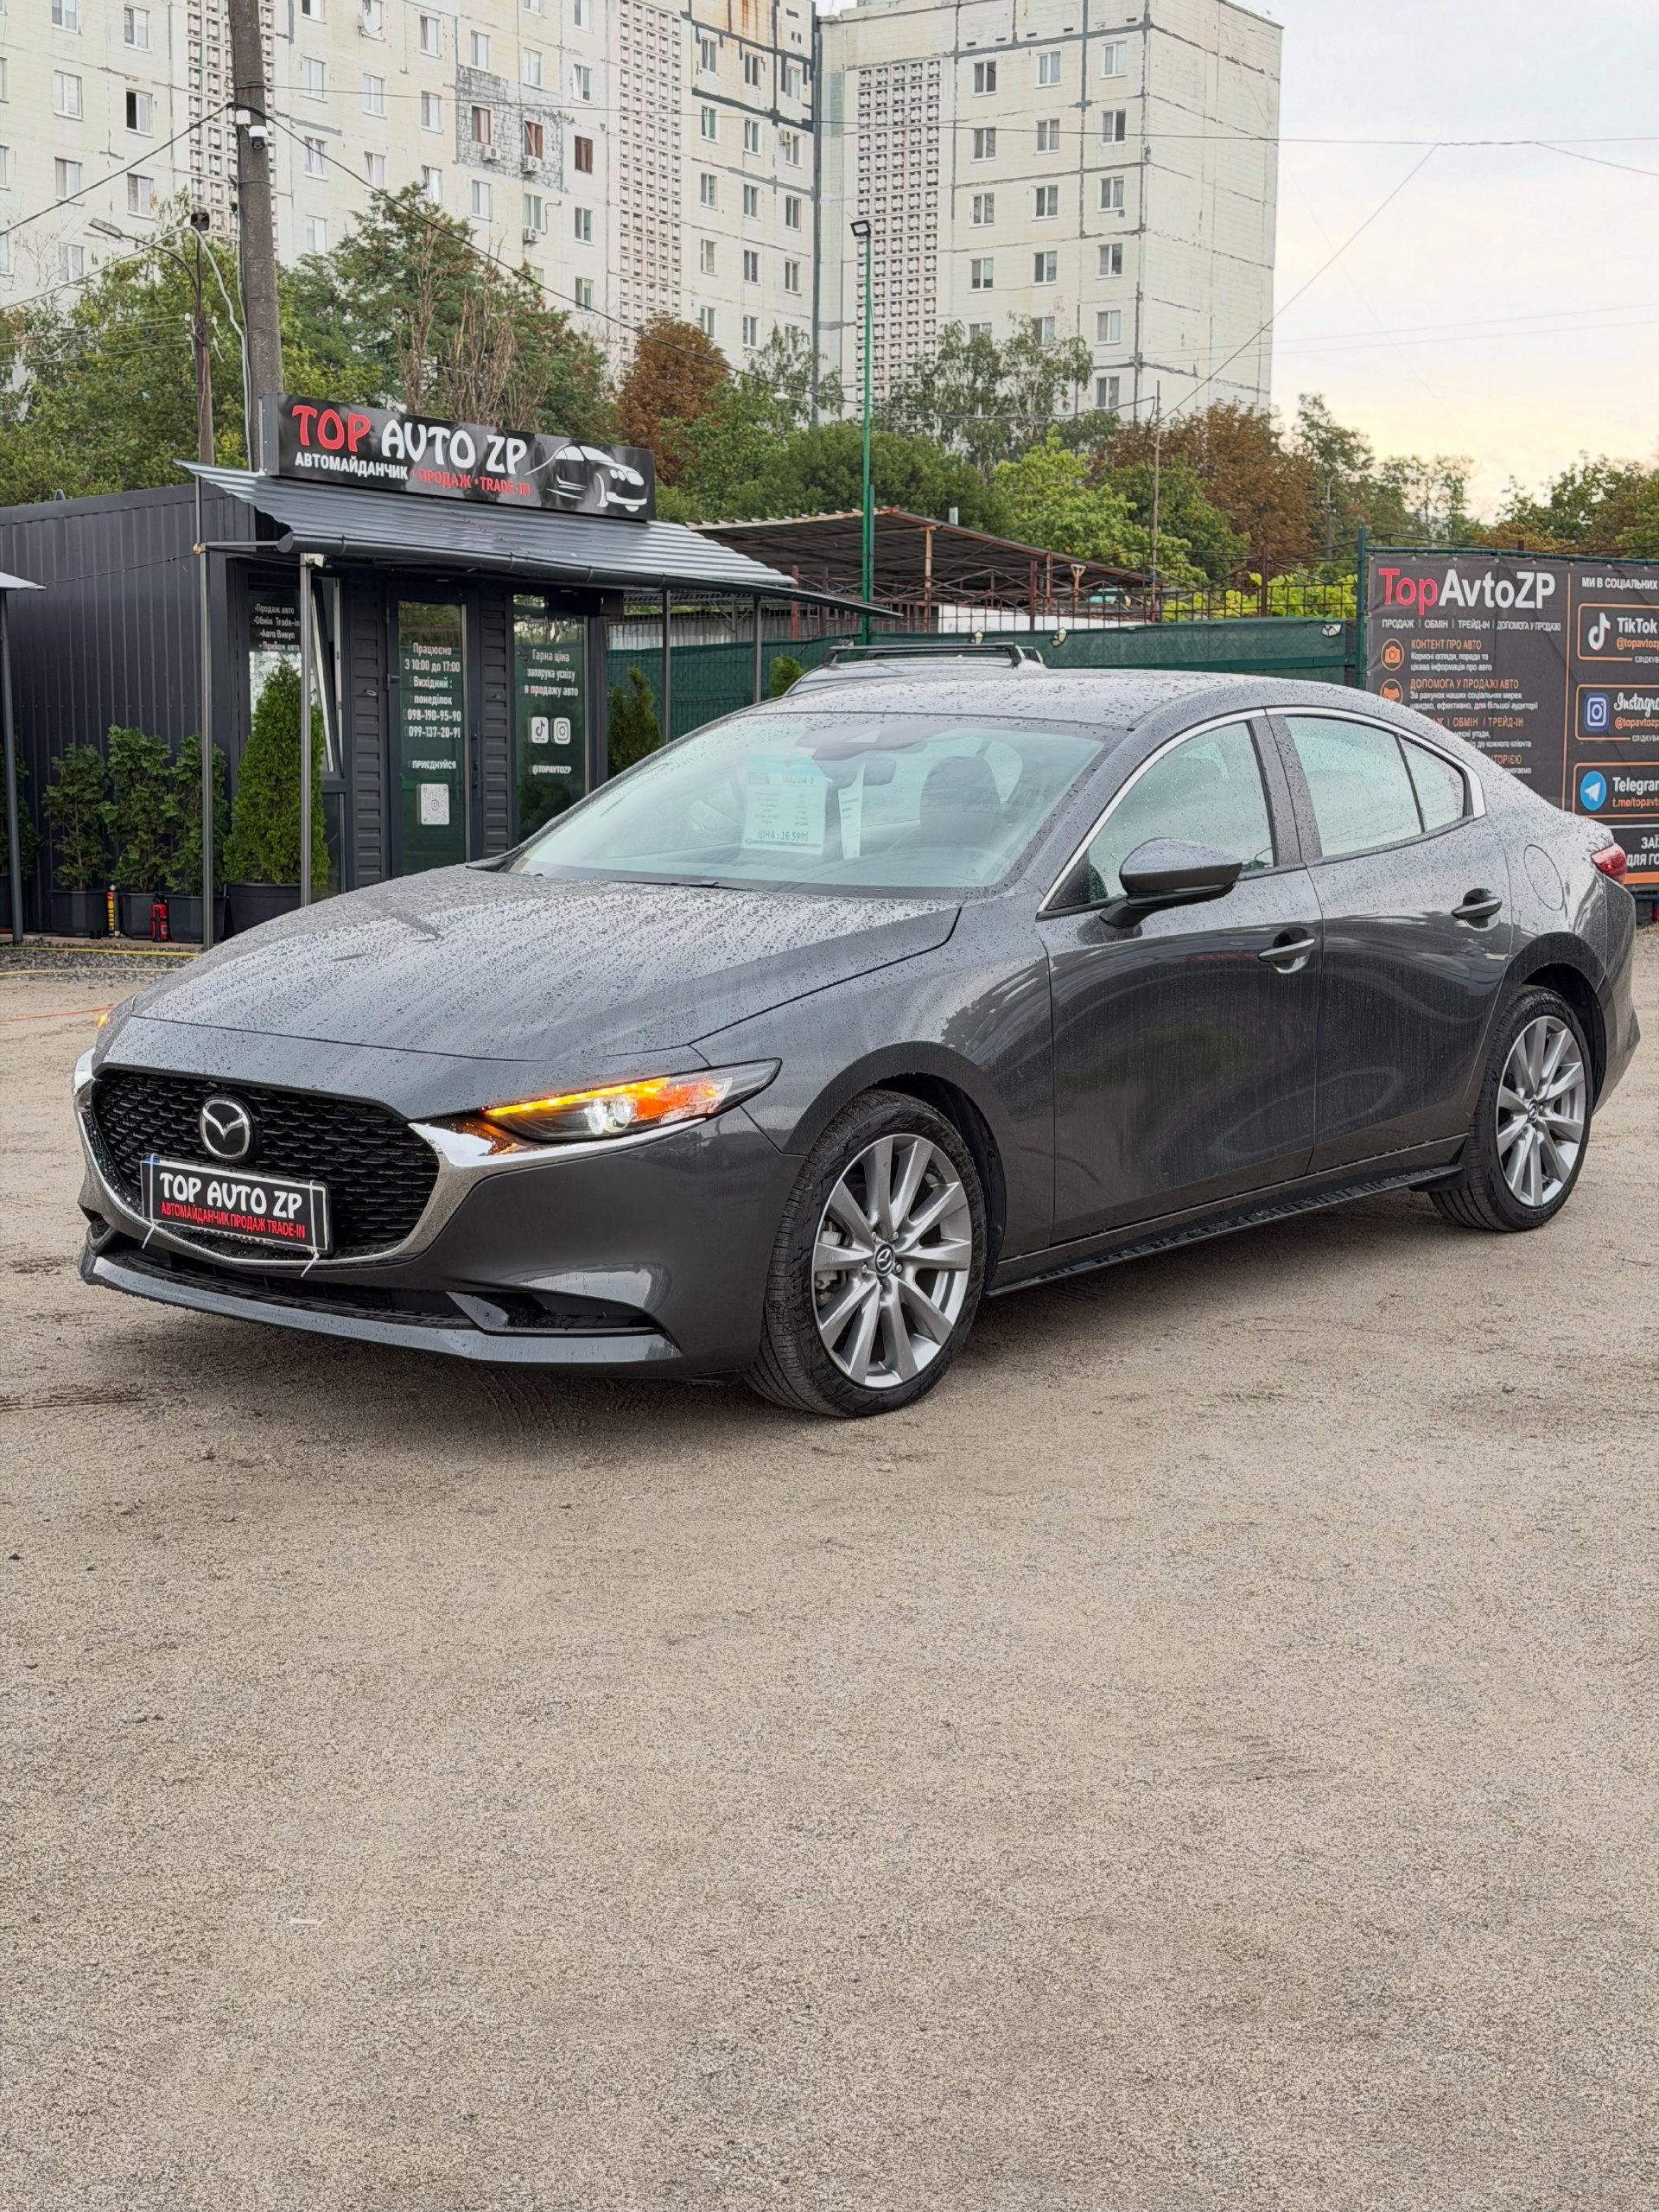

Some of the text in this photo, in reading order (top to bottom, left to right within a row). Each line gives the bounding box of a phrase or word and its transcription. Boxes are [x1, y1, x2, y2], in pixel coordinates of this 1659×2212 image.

[292, 404, 527, 474] TOP AVTO ZP
[295, 451, 408, 480] АВТОМАЙДАНЧИК
[418, 469, 472, 489] ПРОДАЖ
[1581, 577, 1658, 590] МИ В СОЦІАЛЬНИХ
[1378, 568, 1556, 616] TopAvtoZP
[1382, 618, 1561, 632] ПРОДАЖ ОБМІН ТРЕЙД-ІН ДОПОМОГА У ПРОДАЖІ
[1616, 617, 1658, 634] TikTok
[276, 629, 296, 640] Викуп
[413, 642, 452, 657] Працюємо
[1411, 639, 1482, 650] КОНТЕНТ ПРО АВТО
[532, 648, 570, 663] Гарна ціна
[411, 658, 429, 671] 10:00
[431, 662, 441, 673] до
[442, 660, 461, 672] 17:00
[526, 667, 575, 683] запорука успіху
[413, 676, 448, 690] Вихідний
[1409, 678, 1519, 690] ДОПОМОГА У ПРОДАЖІ АВТО
[524, 684, 579, 698] в продажу авто
[1409, 690, 1418, 699] За
[414, 693, 453, 706] понеділок
[407, 709, 461, 722] 098-190-95-90
[1452, 716, 1478, 727] ОБМІН
[1487, 715, 1524, 728] ТРЕЙД-ІН
[408, 726, 461, 739] 099-137-20-91
[412, 760, 456, 771] ПРИЄДНУЙСЯ
[532, 764, 572, 776] @TOPAVTOZP
[1611, 797, 1659, 810] t.me/topavt
[757, 829, 775, 842] ЦІНА
[1640, 834, 1659, 849] ЗАЇ
[1626, 853, 1647, 868] ДЛЯ
[159, 1172, 302, 1219] TOP AVTO ZP
[160, 1201, 230, 1226] АВТОМАЙДАНЧИК
[231, 1213, 266, 1233] ПРОДАЖ
[266, 1219, 306, 1239] TRADE-IN
